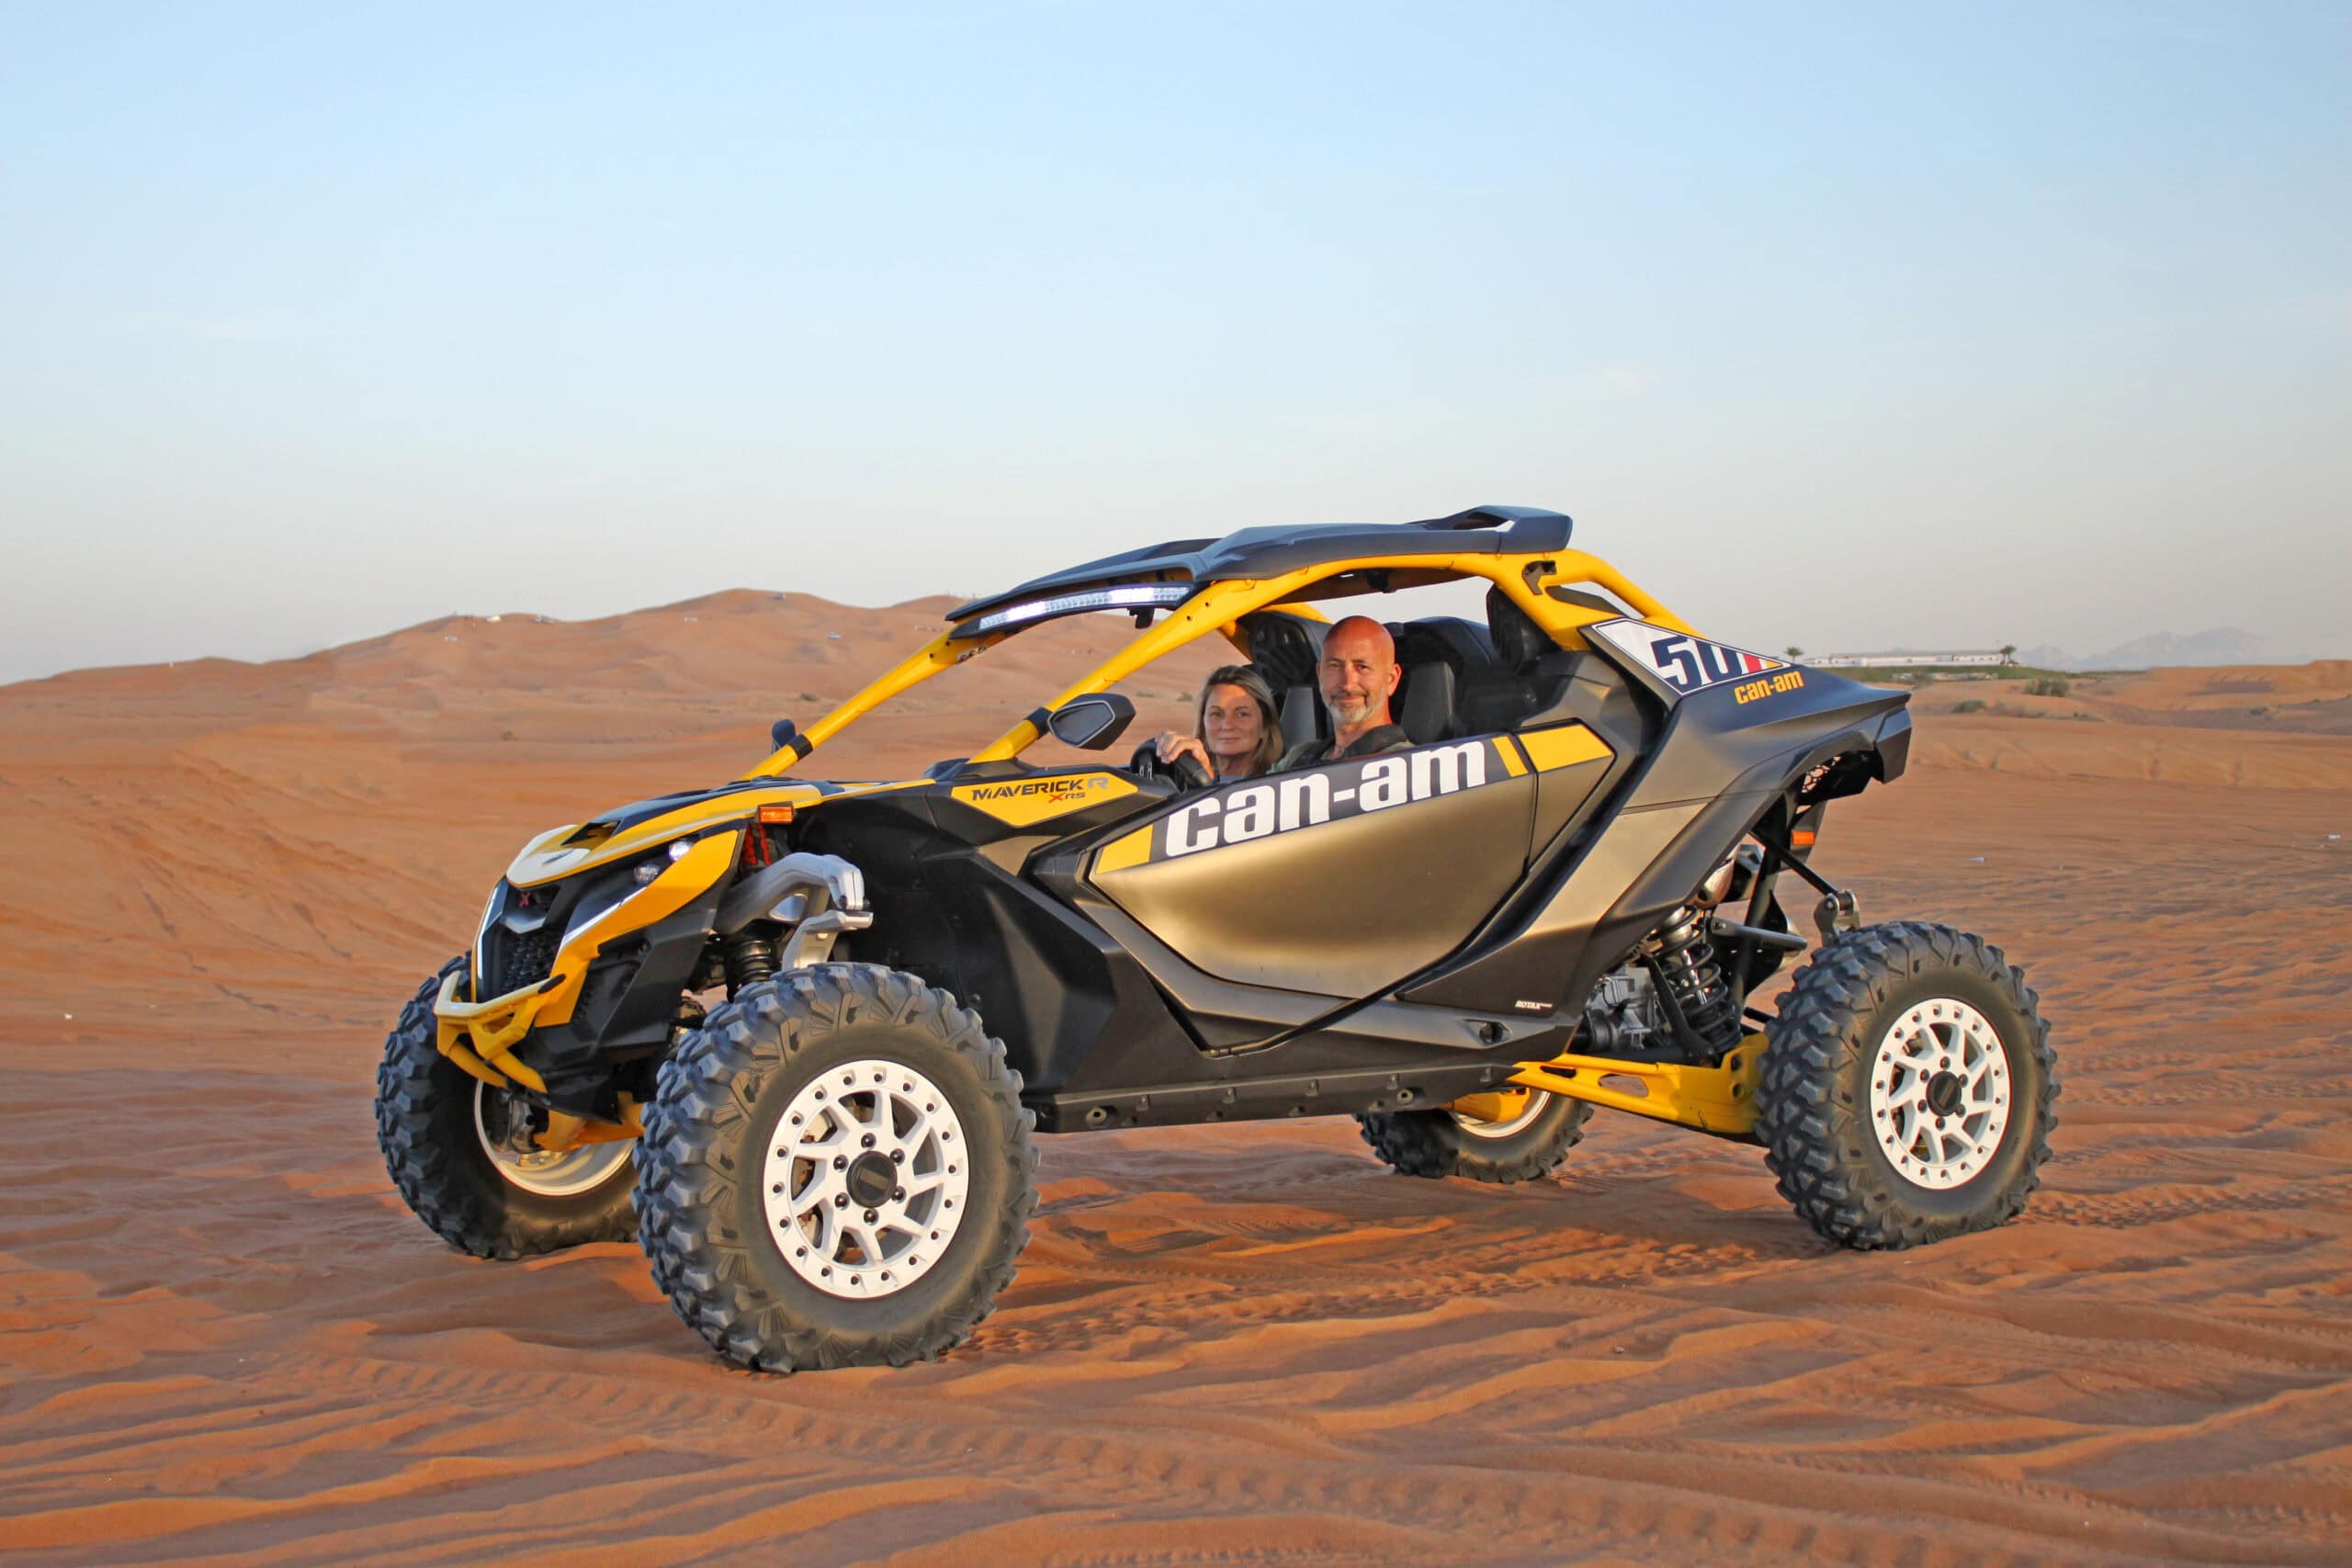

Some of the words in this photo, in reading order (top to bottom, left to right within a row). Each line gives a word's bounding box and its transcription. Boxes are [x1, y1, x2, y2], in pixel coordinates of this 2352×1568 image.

[1734, 671, 1805, 705] can-am
[972, 779, 1084, 801] MAVERICK
[1087, 776, 1110, 790] R
[1166, 740, 1487, 857] can-am
